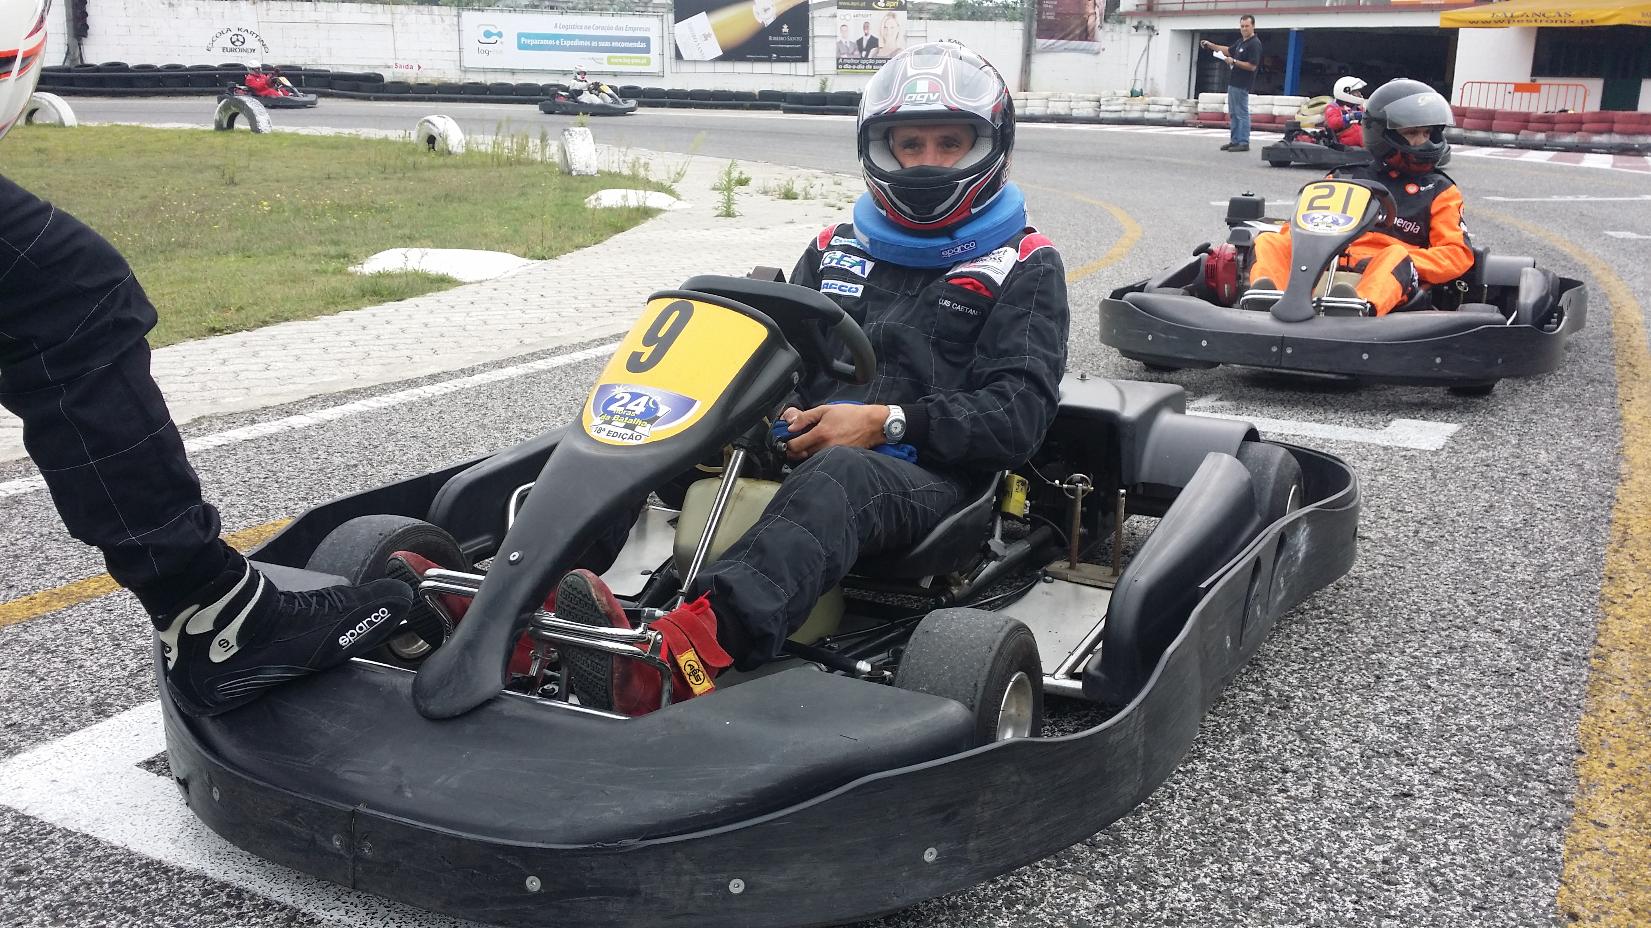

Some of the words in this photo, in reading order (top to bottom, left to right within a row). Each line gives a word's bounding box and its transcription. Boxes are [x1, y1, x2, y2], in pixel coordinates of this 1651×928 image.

[206, 27, 232, 52] ESCOLA
[237, 27, 269, 54] KARTING
[521, 37, 555, 47] Preparamos
[560, 38, 591, 47] Expedimos
[612, 41, 647, 49] encomendas
[1307, 184, 1354, 215] 21
[941, 241, 976, 258] sparco
[938, 298, 951, 307] LUIS
[625, 300, 695, 374] 9
[607, 392, 650, 415] 24
[612, 414, 648, 428] Batalha
[606, 429, 642, 441] EDIÇÃO
[338, 606, 391, 649] sparco
